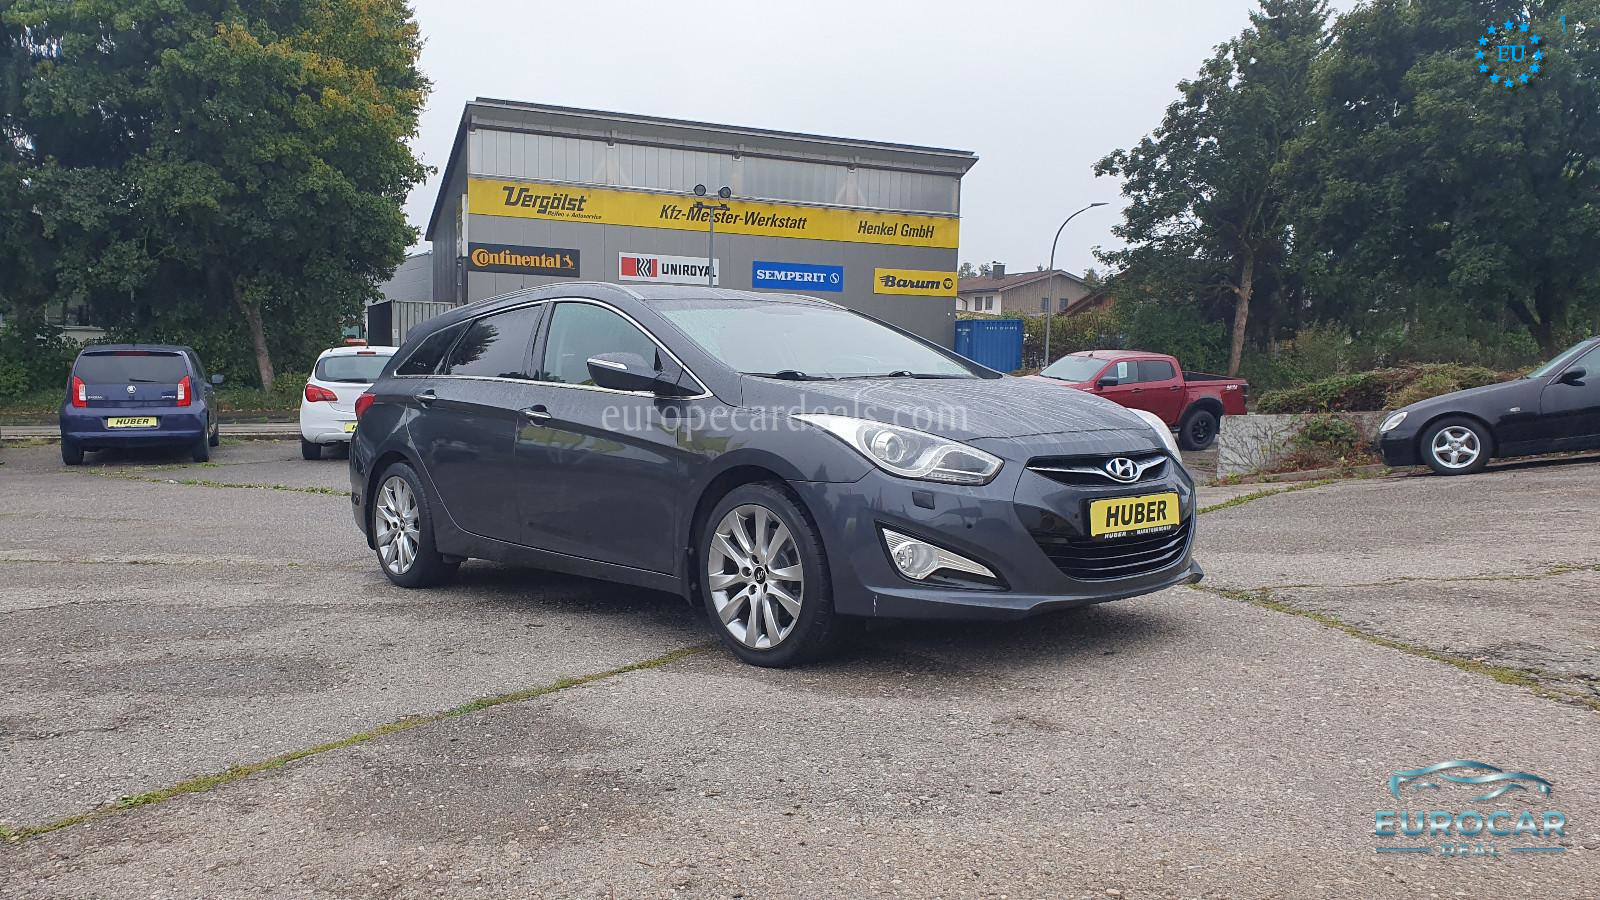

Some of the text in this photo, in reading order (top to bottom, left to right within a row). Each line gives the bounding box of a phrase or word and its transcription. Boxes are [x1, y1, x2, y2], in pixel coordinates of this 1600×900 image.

[502, 186, 588, 215] Vergölst
[659, 204, 808, 229] Kfz-Mester-Werkstatt
[858, 220, 935, 240] Henkel GmbH
[471, 248, 561, 269] Continental
[756, 269, 827, 284] SEMPERIT
[882, 274, 941, 290] Barum
[1105, 500, 1168, 528] HUBER
